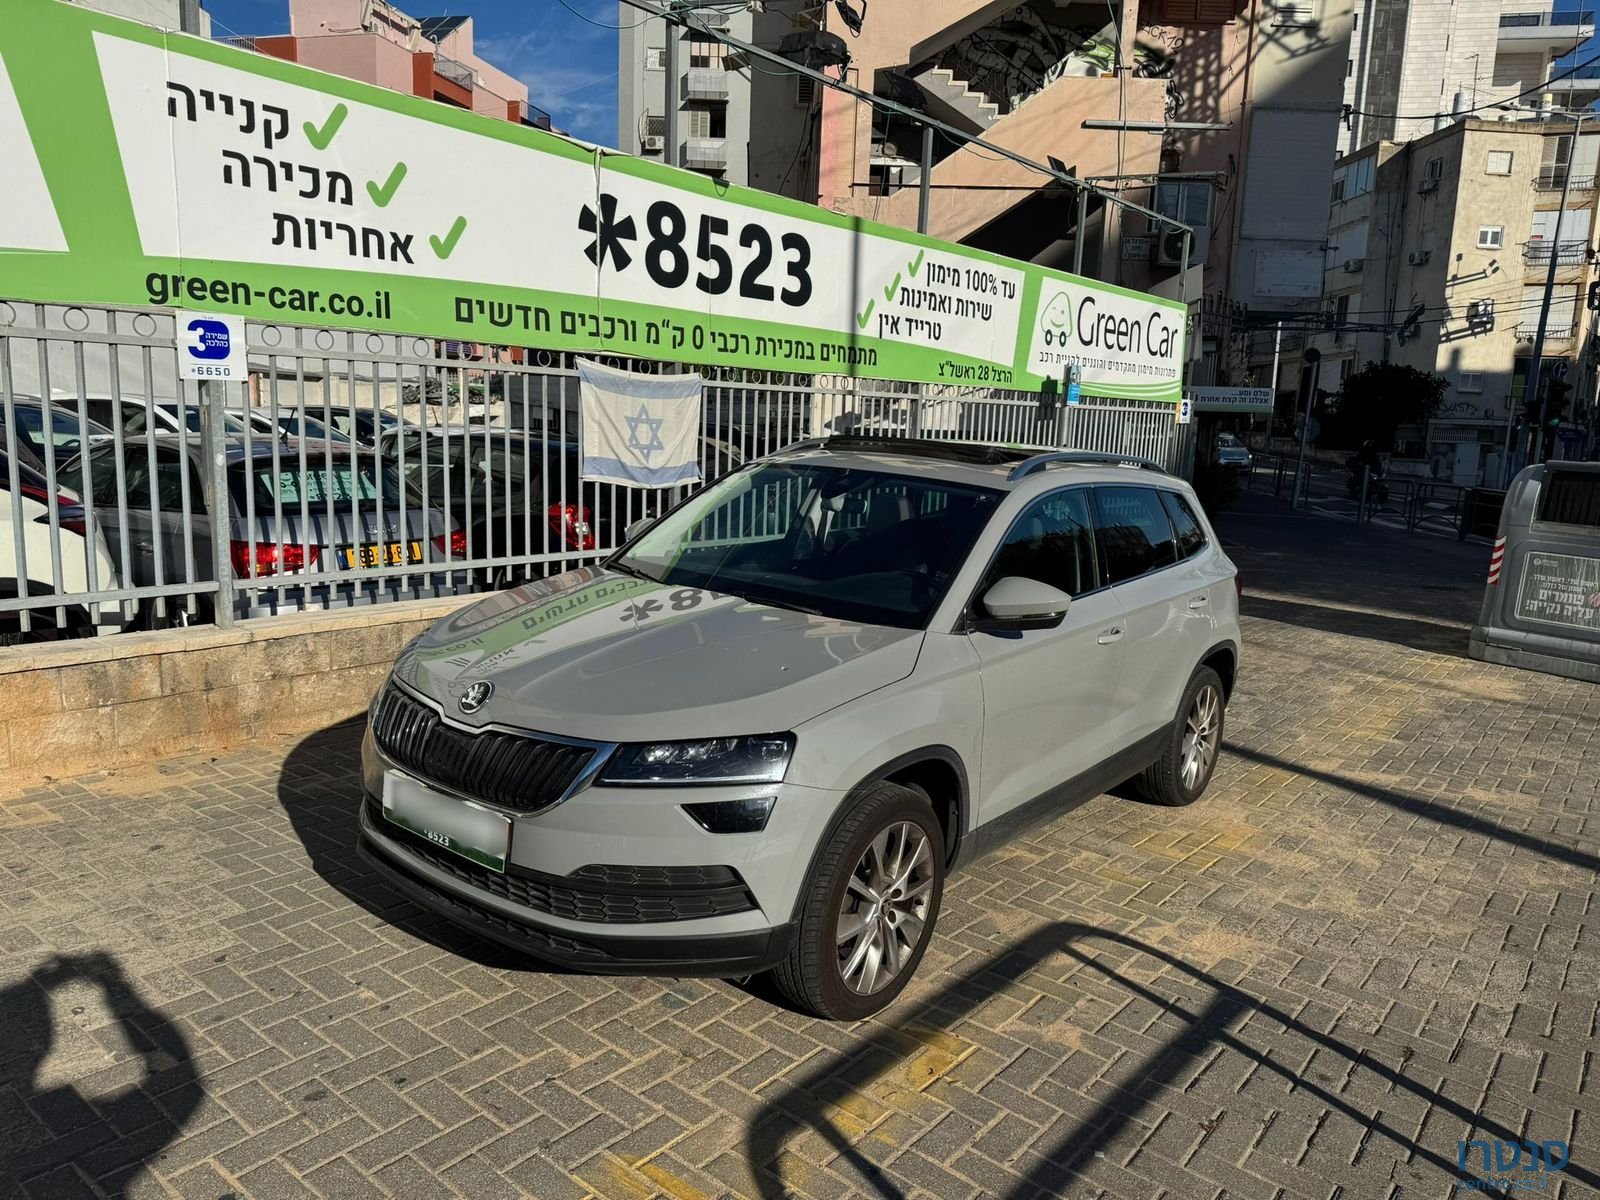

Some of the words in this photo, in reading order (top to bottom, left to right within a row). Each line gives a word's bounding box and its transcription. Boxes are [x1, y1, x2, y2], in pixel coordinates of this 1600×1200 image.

[167, 82, 290, 150] קנייה
[223, 149, 353, 206] מכירה
[271, 212, 415, 265] אחריות
[926, 262, 961, 288] מימון
[965, 268, 998, 296] 100%
[146, 272, 391, 321] green-car.co.il
[899, 286, 952, 315] ואמינות
[1001, 280, 1016, 300] עד
[454, 296, 552, 333] חדשים
[955, 297, 993, 322] שירות
[205, 332, 228, 340] שמירה
[560, 310, 638, 342] ורכבים
[692, 324, 704, 351] 0
[878, 313, 901, 340] אין
[905, 317, 943, 342] טרייד
[1077, 296, 1142, 354] Green
[1146, 311, 1179, 359] Car
[710, 331, 750, 355] רכבי
[755, 335, 816, 361] במכירת
[820, 343, 878, 367] מתמחים
[1039, 351, 1054, 364] רכב
[1107, 359, 1136, 375] מתקדמים
[1137, 364, 1153, 377] מימון
[977, 364, 990, 381] 28
[991, 365, 1013, 384] הרצל
[1538, 589, 1585, 606] שומרים
